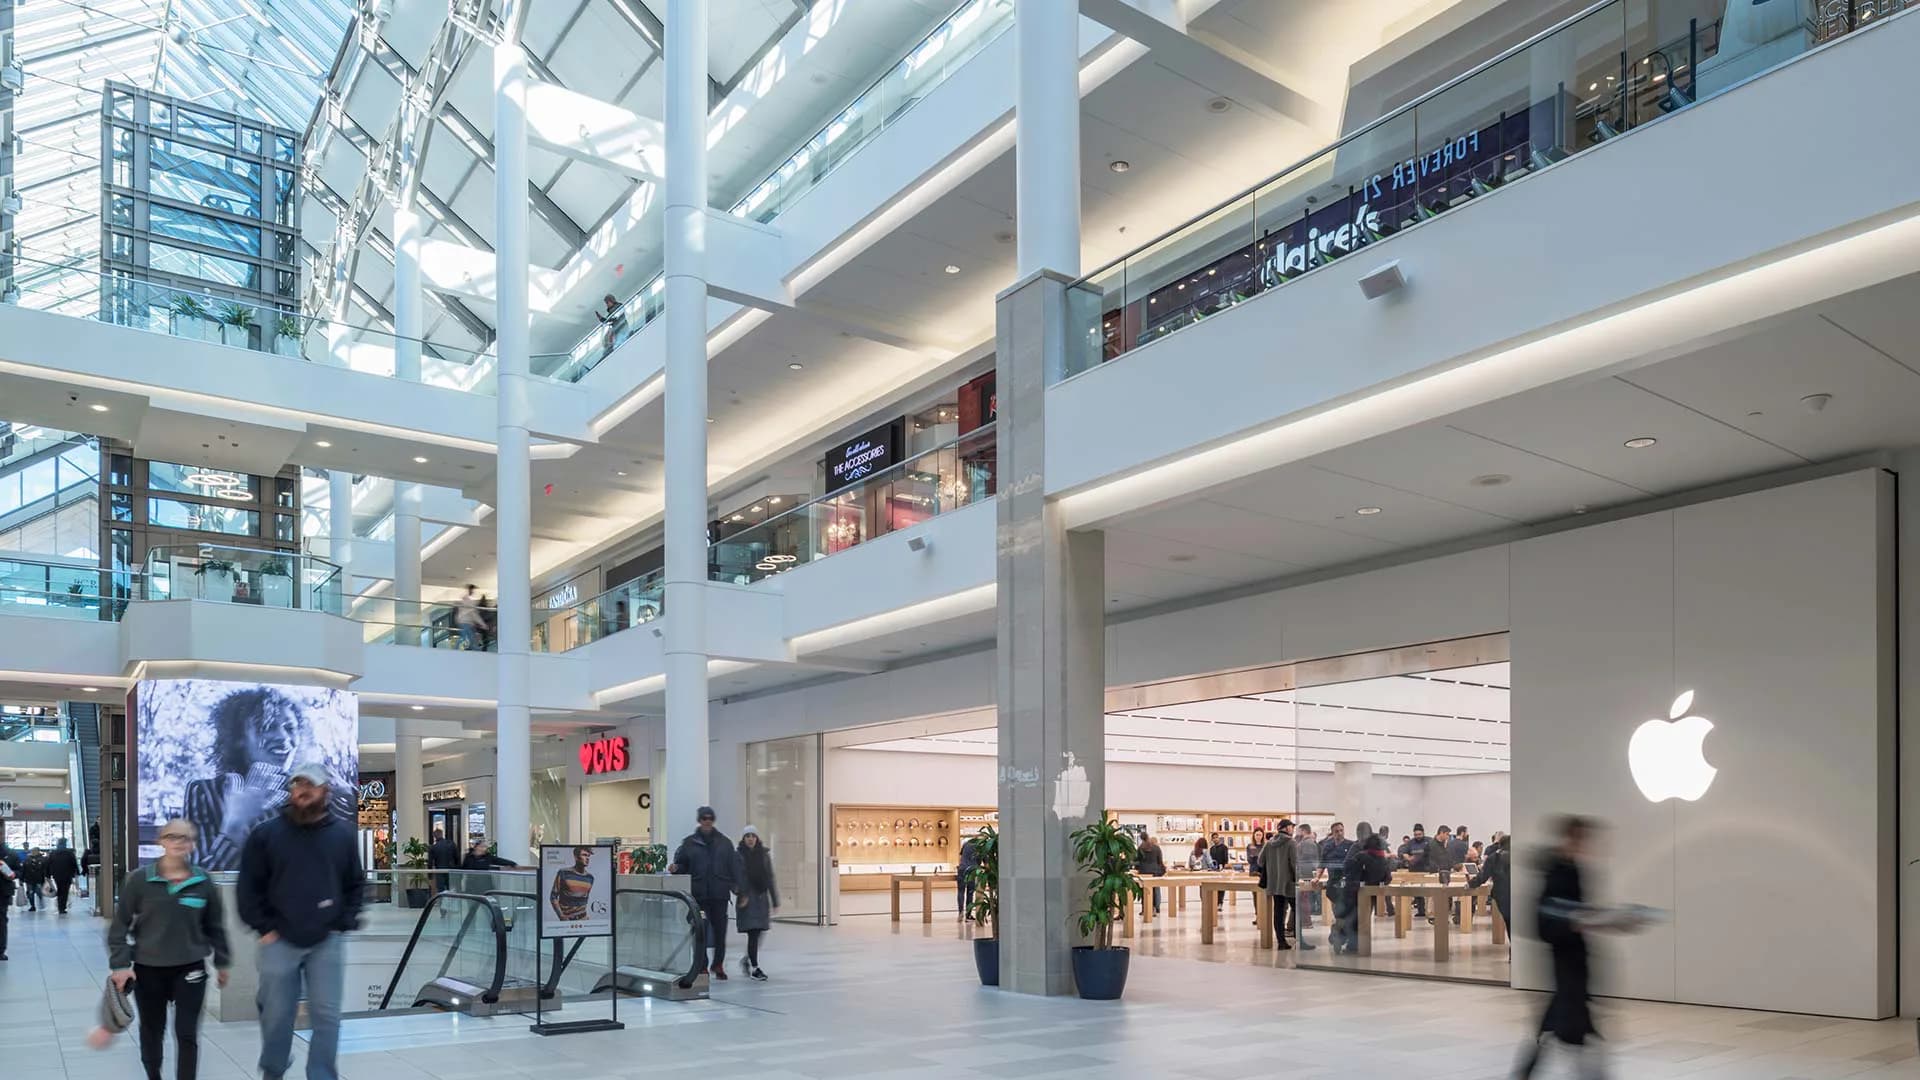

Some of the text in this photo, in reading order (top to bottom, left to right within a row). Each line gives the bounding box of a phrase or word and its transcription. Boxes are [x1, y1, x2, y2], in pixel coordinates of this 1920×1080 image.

[834, 462, 844, 476] THE
[844, 444, 885, 471] ACCESSORIES
[593, 736, 629, 774] CVS
